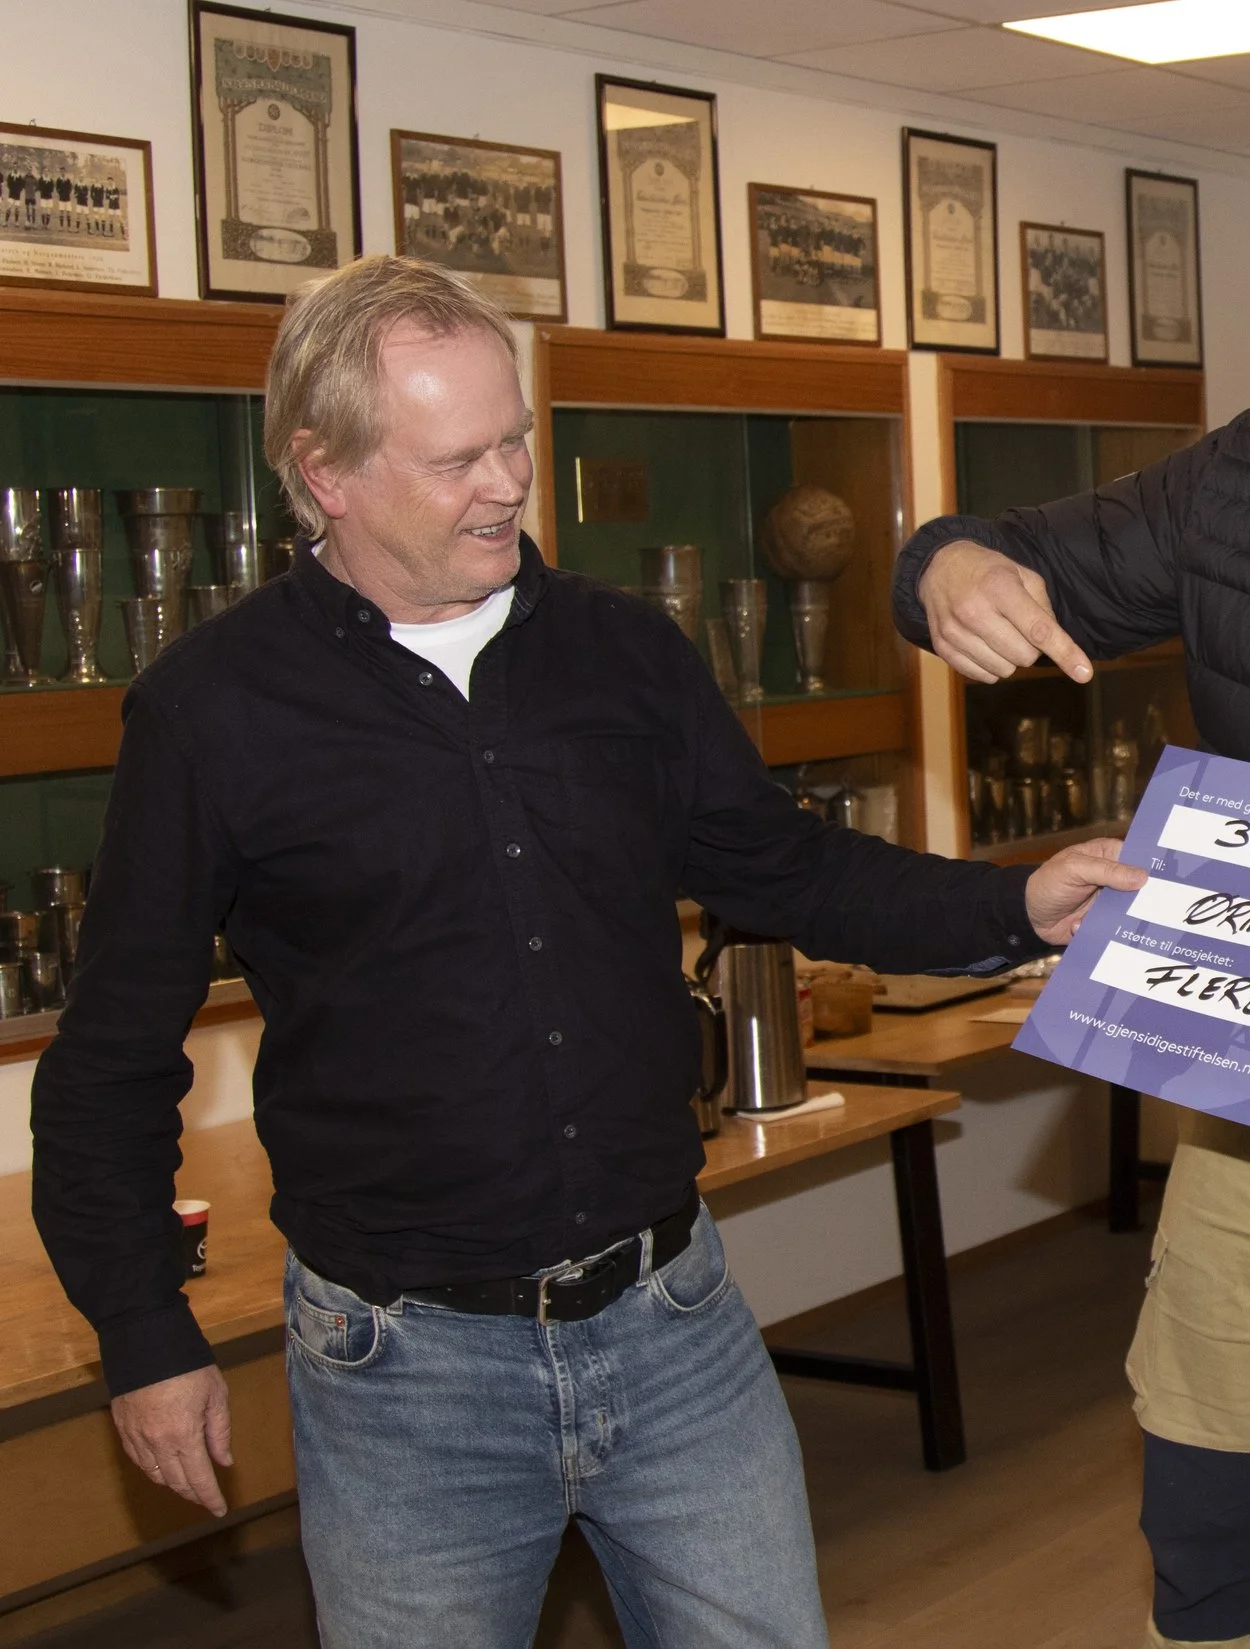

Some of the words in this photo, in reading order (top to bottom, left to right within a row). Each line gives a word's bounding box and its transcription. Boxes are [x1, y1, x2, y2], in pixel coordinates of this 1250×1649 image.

[1179, 786, 1200, 800] Det
[1202, 794, 1214, 803] er
[1216, 797, 1243, 810] med
[1151, 857, 1166, 871] Til:
[1115, 925, 1122, 936] I
[1121, 929, 1157, 947] støtte
[1160, 939, 1173, 952] til
[1172, 944, 1235, 968] prosjektet:
